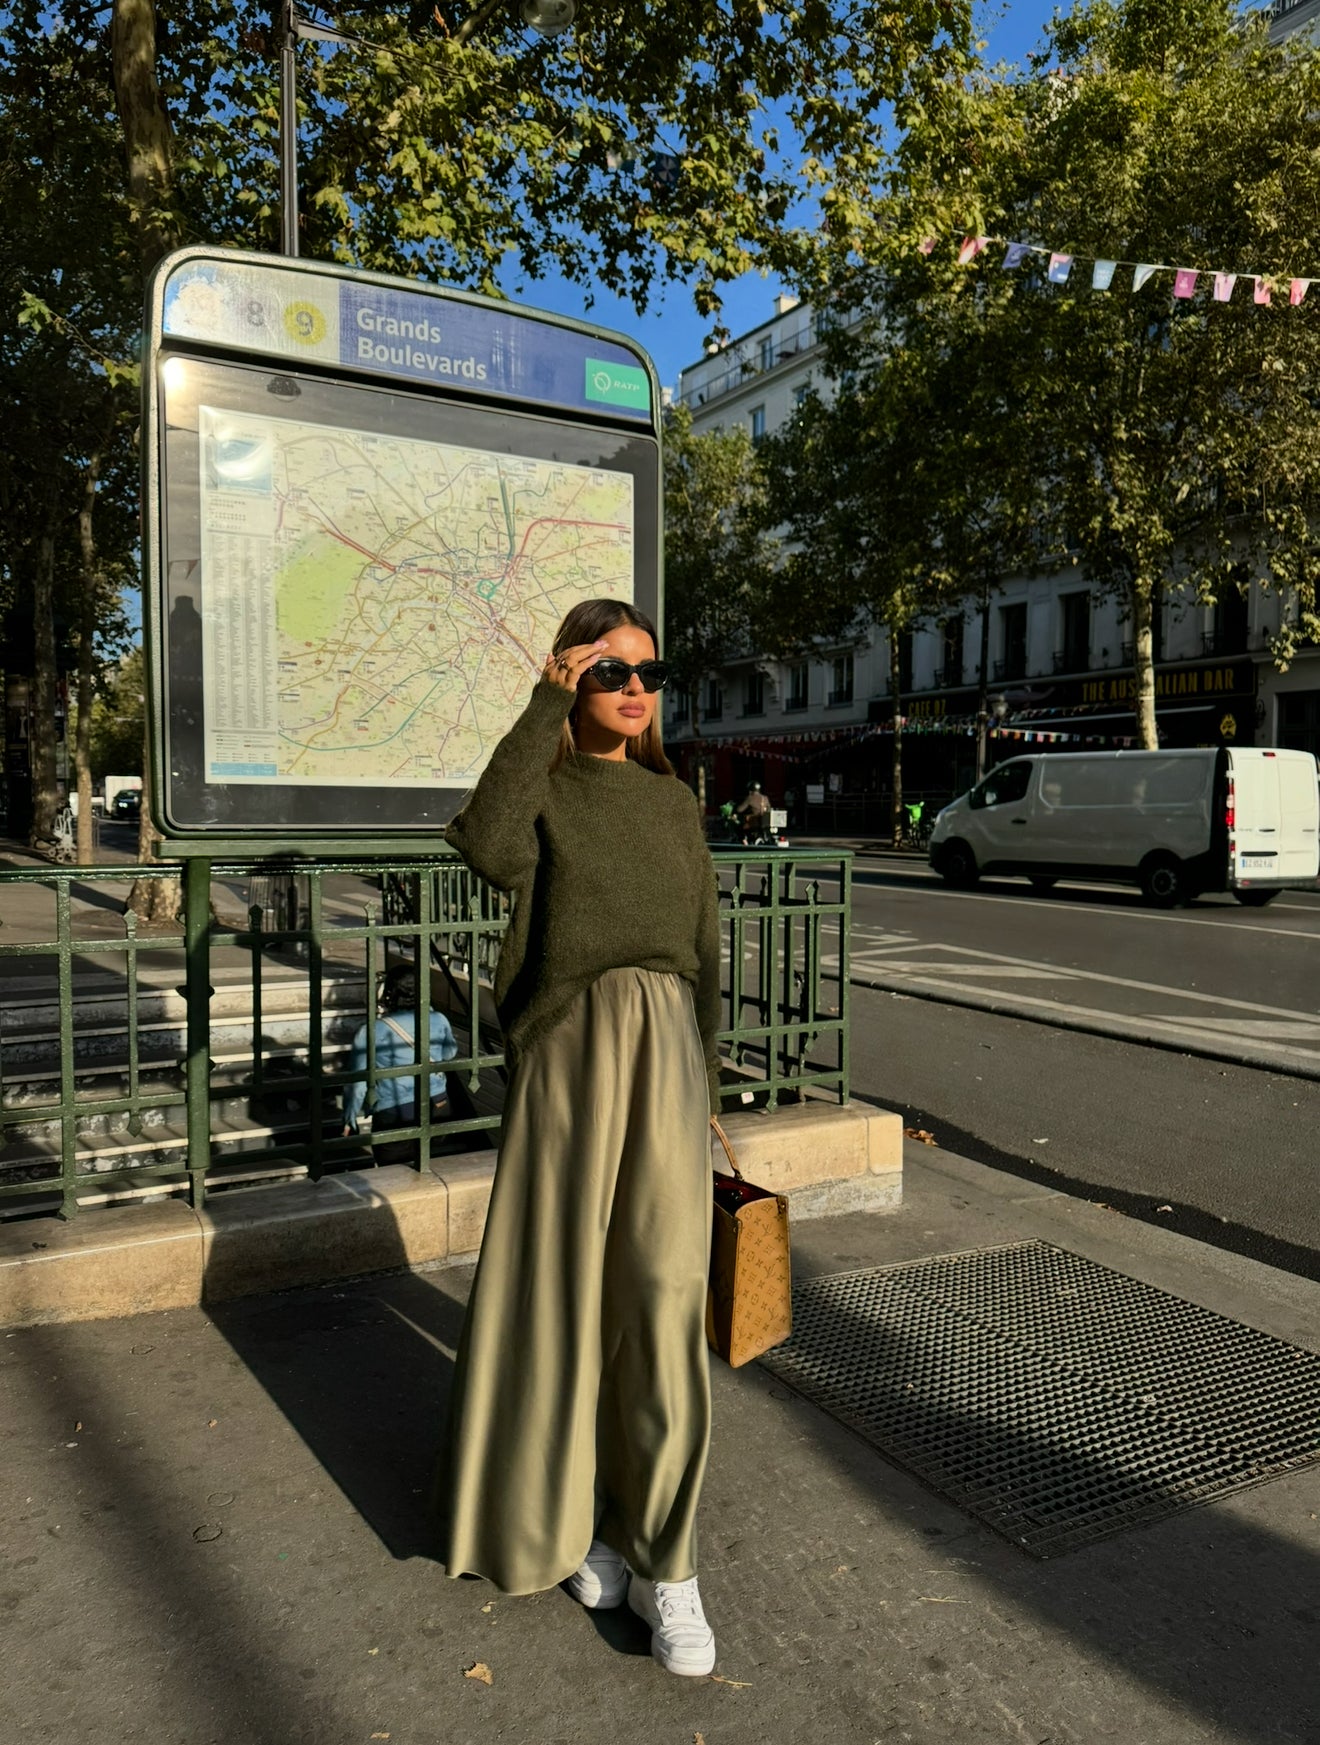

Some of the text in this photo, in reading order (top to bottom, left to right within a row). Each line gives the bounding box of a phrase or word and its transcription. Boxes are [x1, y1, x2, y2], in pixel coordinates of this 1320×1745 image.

[247, 300, 314, 337] 8 9
[356, 306, 441, 345] Grands
[356, 335, 488, 381] Boulevards
[613, 380, 641, 392] RATP
[1081, 667, 1235, 704] THE AUSALIAN BAR
